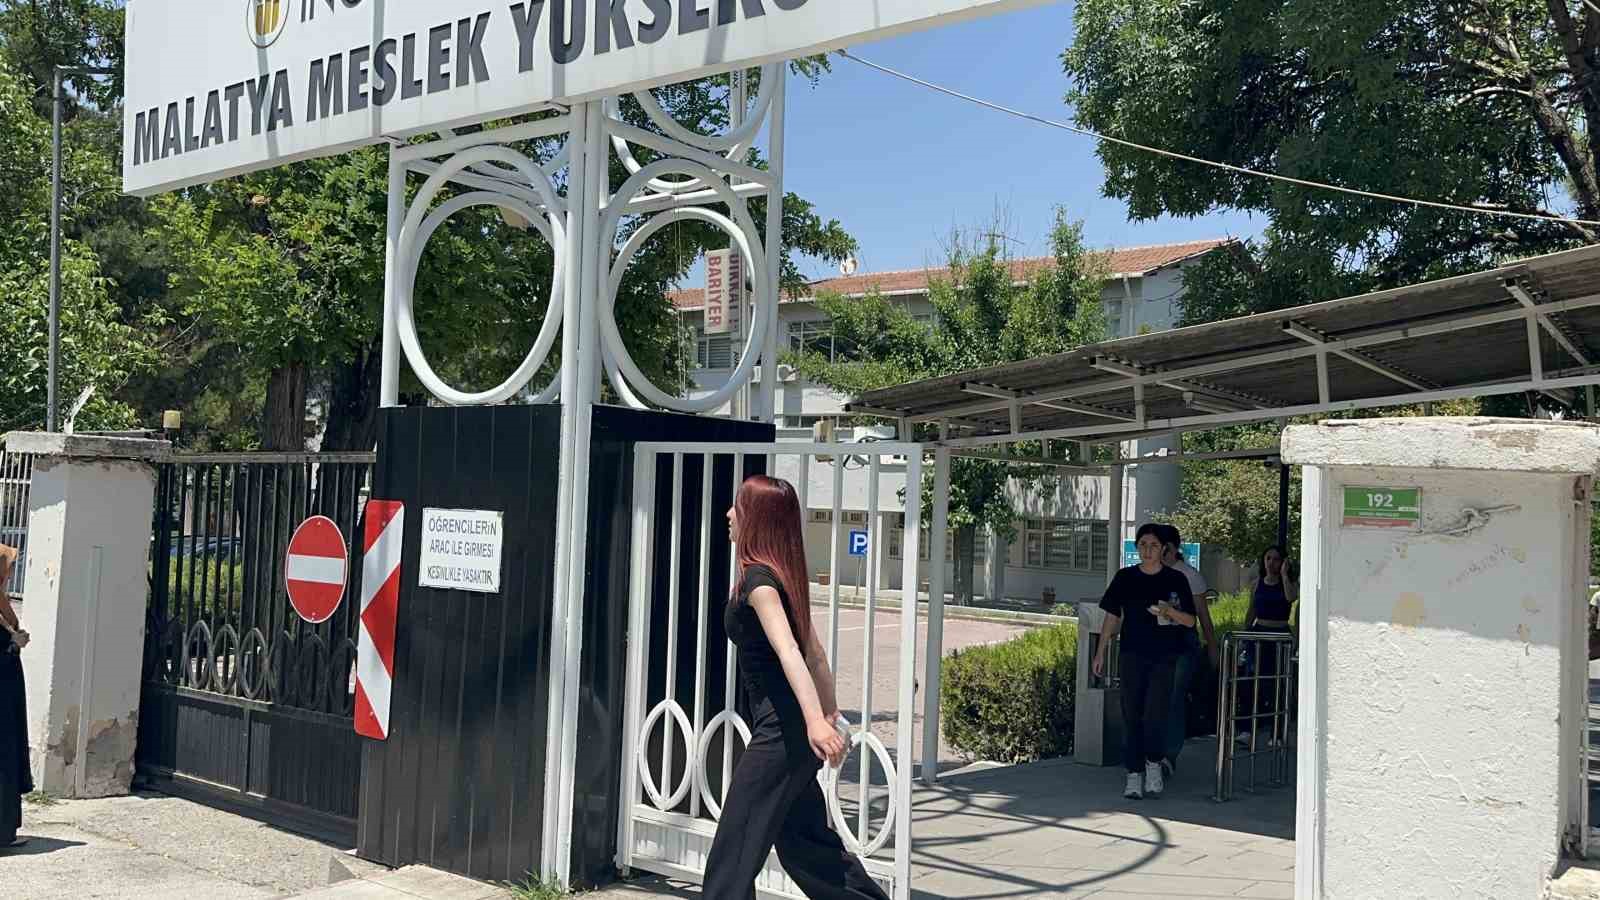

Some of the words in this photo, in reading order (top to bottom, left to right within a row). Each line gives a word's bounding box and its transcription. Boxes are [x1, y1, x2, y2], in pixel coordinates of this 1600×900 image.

[133, 68, 293, 165] MALATYA
[306, 11, 491, 122] MESLEK
[1366, 493, 1393, 507] 192
[854, 534, 868, 552] P
